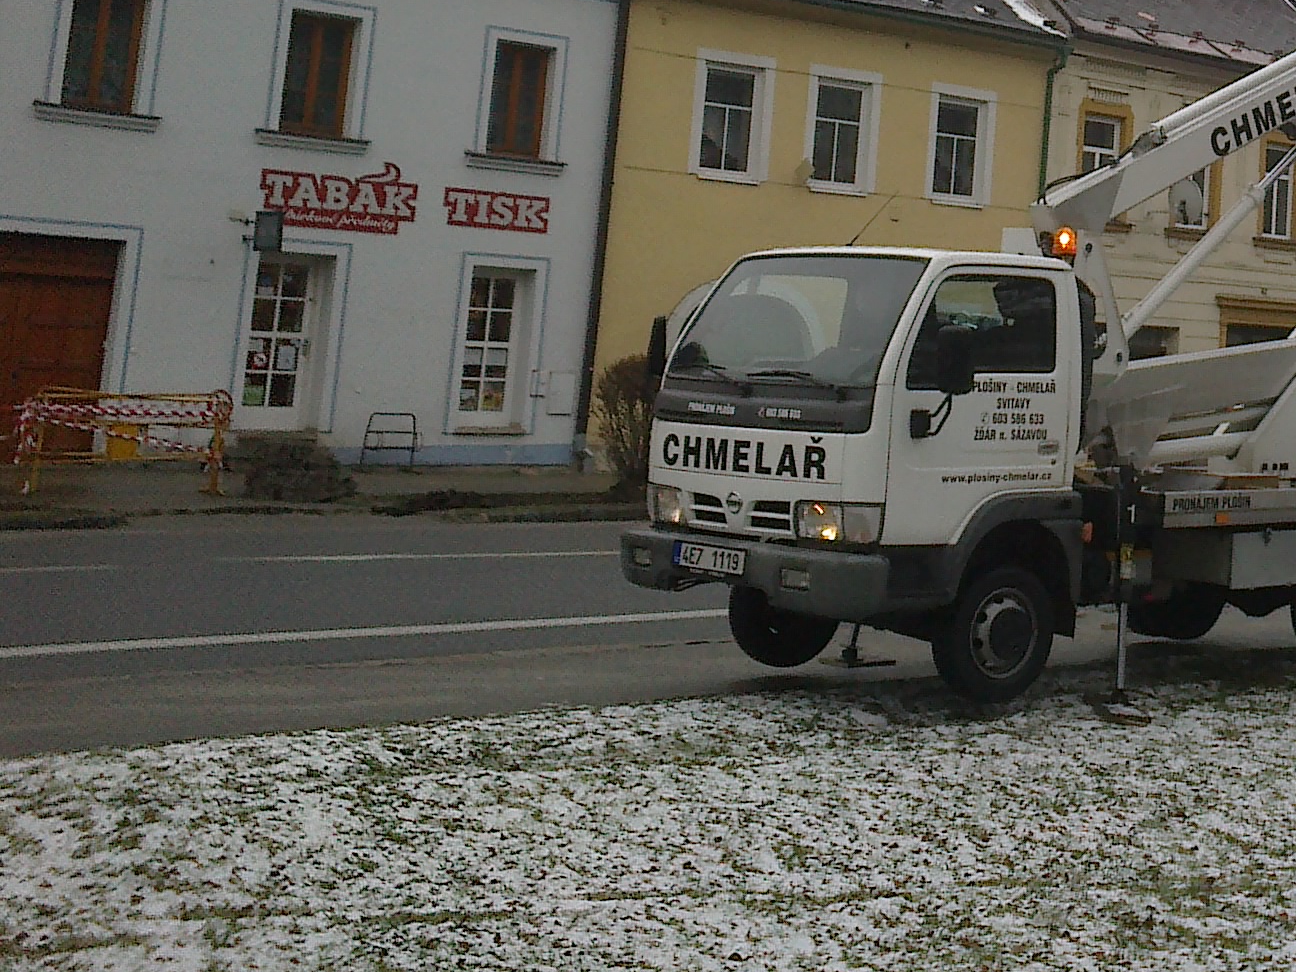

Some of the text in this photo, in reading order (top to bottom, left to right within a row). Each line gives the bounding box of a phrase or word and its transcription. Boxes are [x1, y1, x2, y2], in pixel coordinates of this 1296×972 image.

[449, 192, 548, 229] TISK
[1017, 379, 1056, 394] CHMELAŘ
[996, 397, 1031, 410] SVITAVY
[992, 413, 1008, 424] 603
[663, 433, 827, 480] CHMELAŘ
[1127, 503, 1136, 524] 1
[682, 546, 740, 571] 4E7 1119
